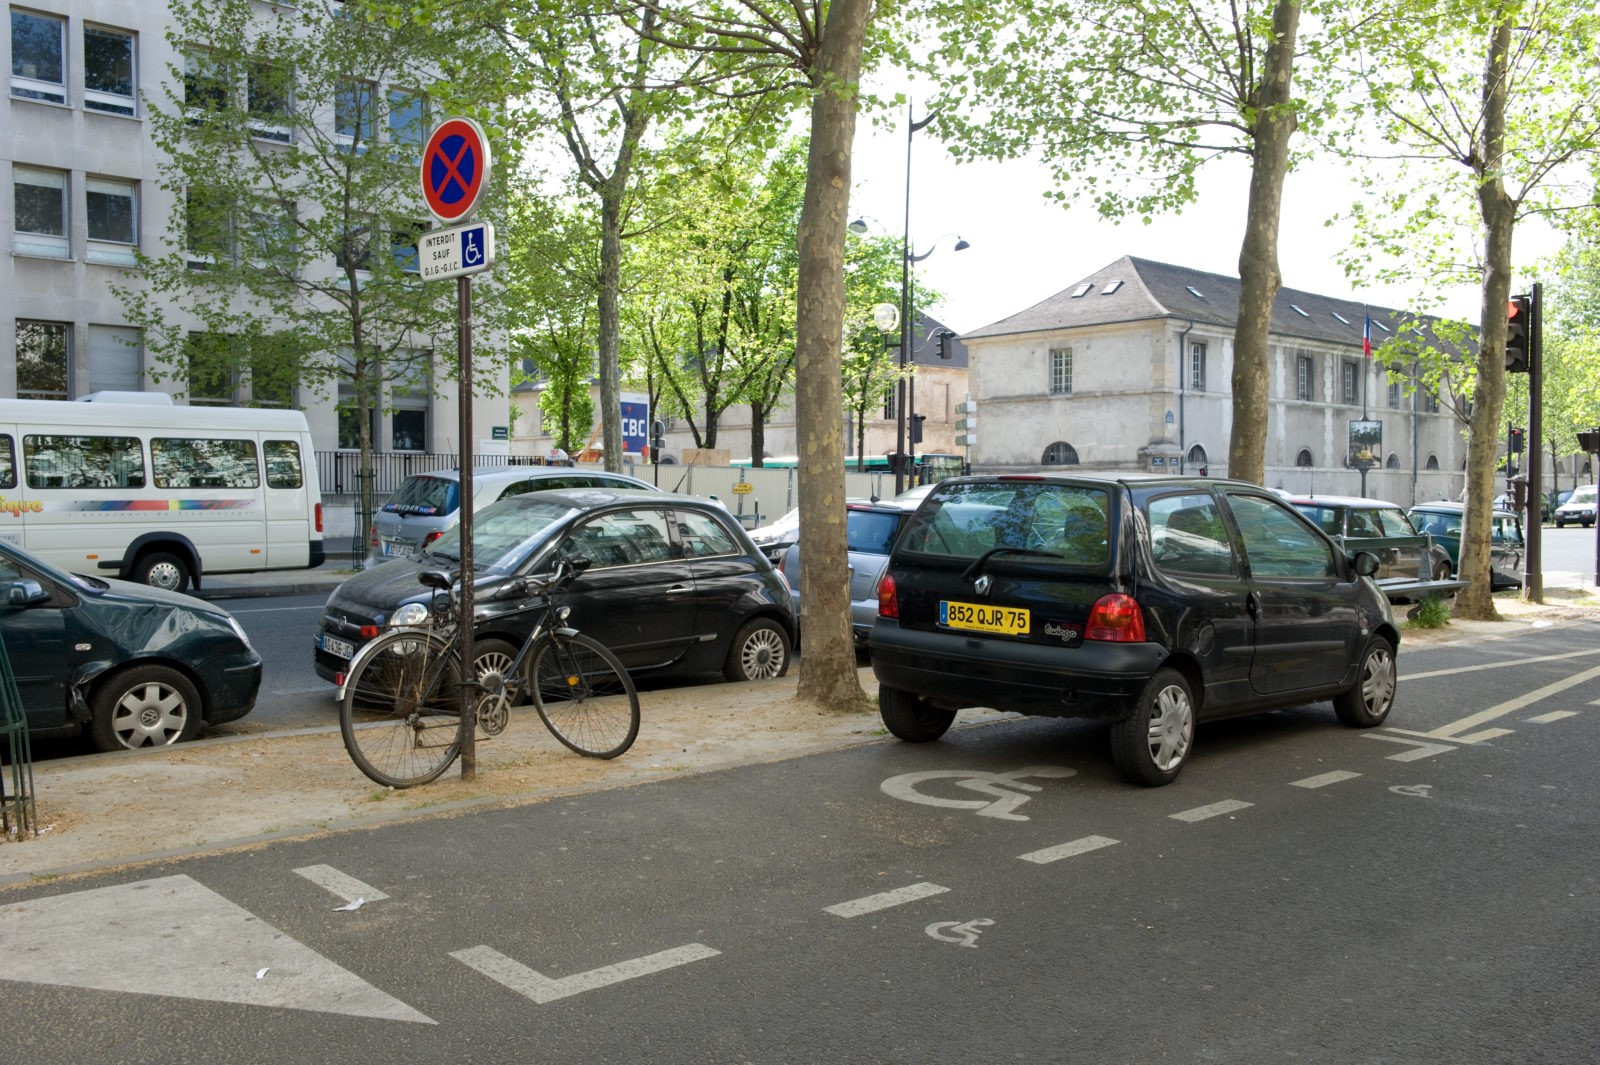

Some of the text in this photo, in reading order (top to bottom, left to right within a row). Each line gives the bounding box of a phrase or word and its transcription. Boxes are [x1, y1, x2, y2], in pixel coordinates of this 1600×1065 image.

[426, 233, 455, 248] INTERDIT
[433, 249, 450, 261] SAUF
[949, 605, 974, 623] 852
[978, 608, 1003, 627] QJR
[1008, 611, 1026, 629] 75
[1045, 622, 1077, 641] twingo
